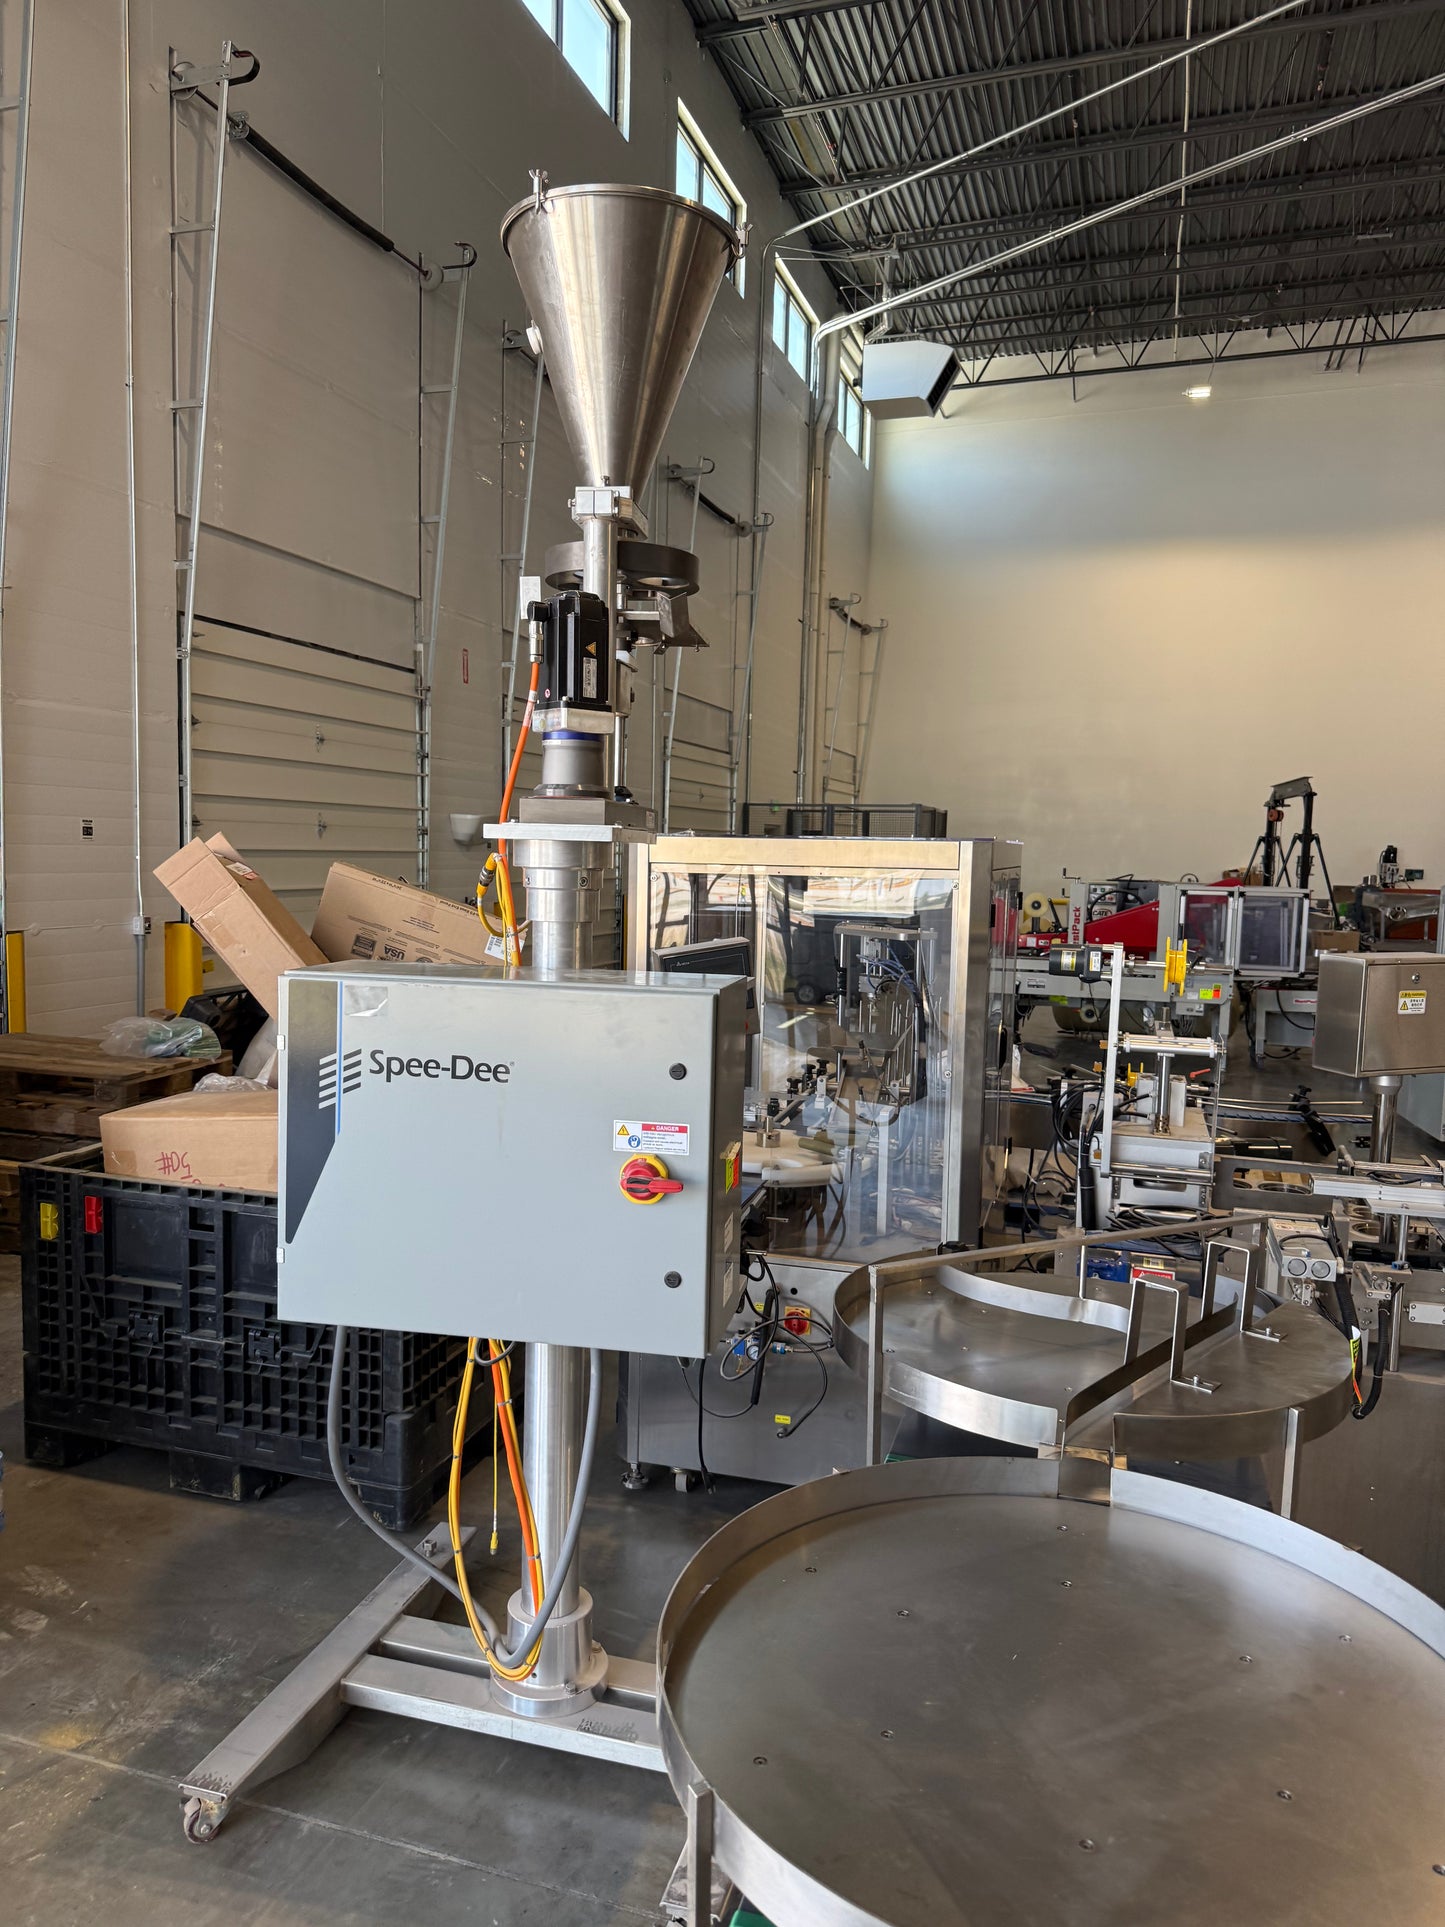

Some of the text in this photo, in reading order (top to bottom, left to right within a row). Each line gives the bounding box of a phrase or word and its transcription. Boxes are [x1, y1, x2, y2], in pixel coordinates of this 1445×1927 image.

[1072, 906, 1081, 944] stPack
[384, 946, 406, 960] USA
[369, 1049, 511, 1083] Spee-Dee
